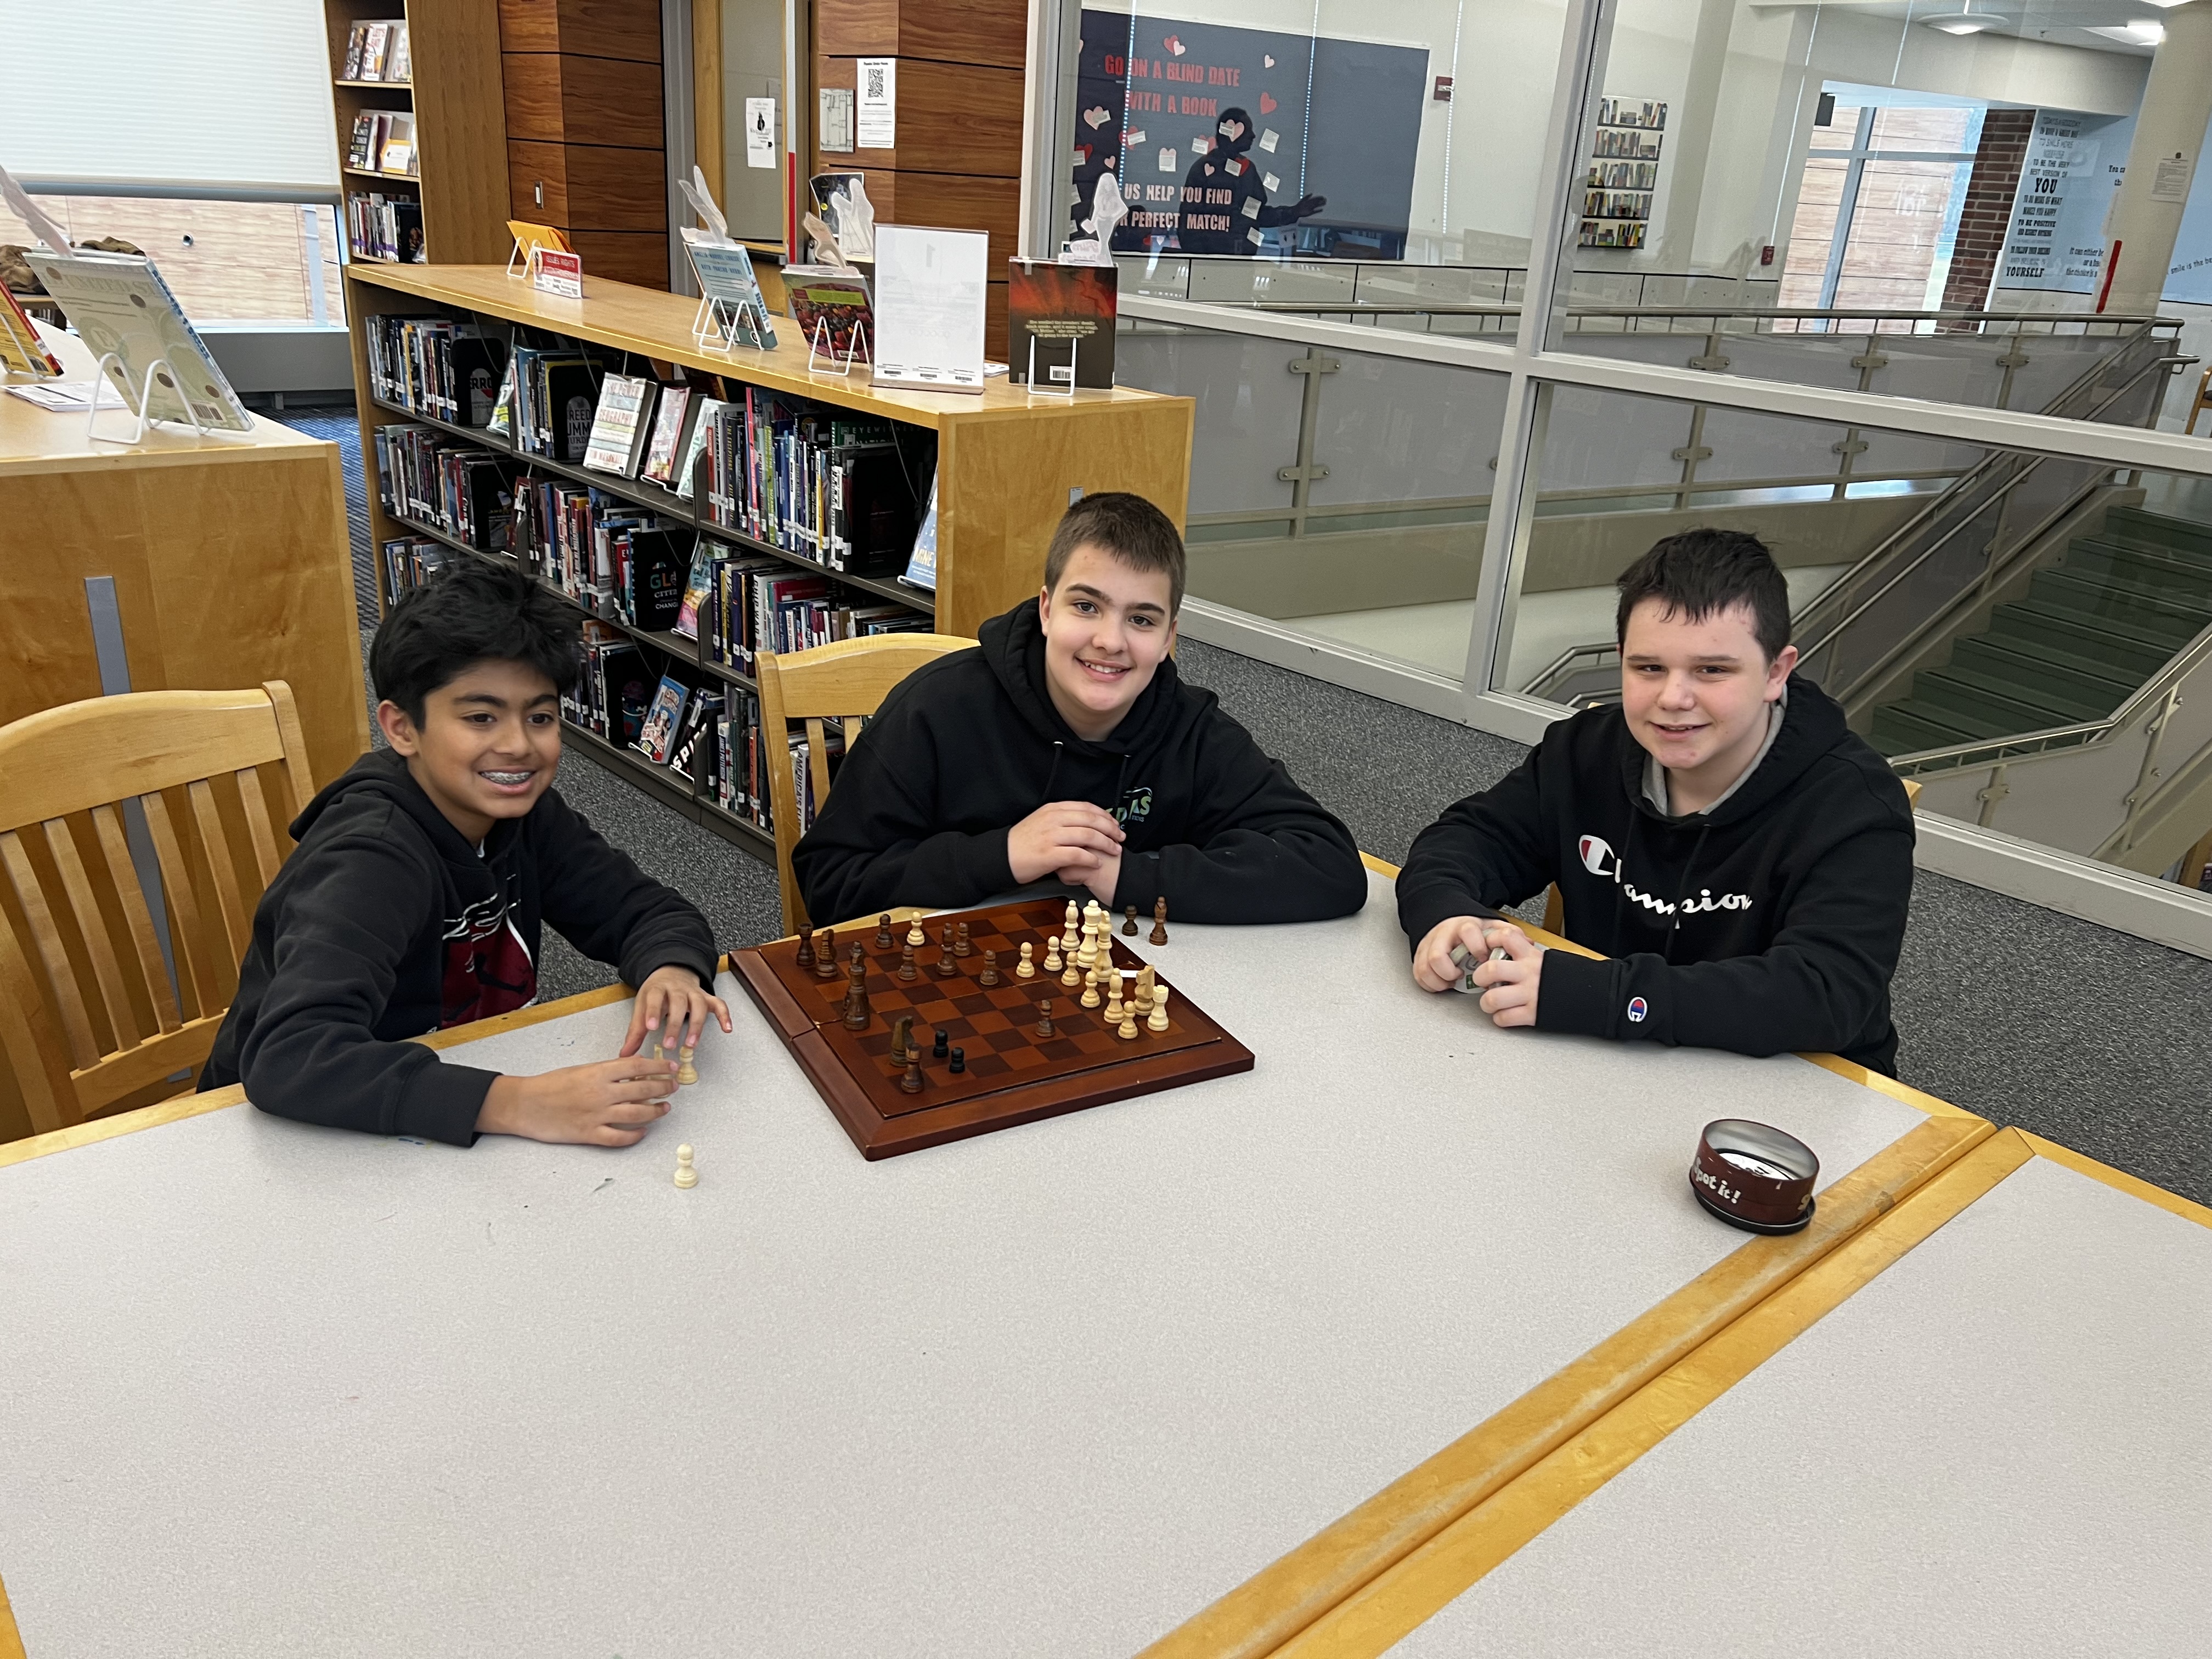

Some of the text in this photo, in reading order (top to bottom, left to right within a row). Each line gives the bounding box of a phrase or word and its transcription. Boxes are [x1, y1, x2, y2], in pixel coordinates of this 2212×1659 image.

[1105, 54, 1240, 87] GO ON A BLIND DATE
[1126, 91, 1217, 117] WITH A BOOK
[1124, 183, 1232, 205] US HELP YOU FIND
[2035, 178, 2058, 194] YOU
[1131, 211, 1181, 228] PERFECT
[1187, 213, 1231, 232] MATCH!
[2006, 267, 2045, 277] YOURSELF
[2171, 264, 2185, 274] smile
[2194, 259, 2204, 268] the
[569, 409, 591, 421] REED
[795, 751, 804, 805] AMERICA'S
[1718, 1179, 1741, 1204] it!
